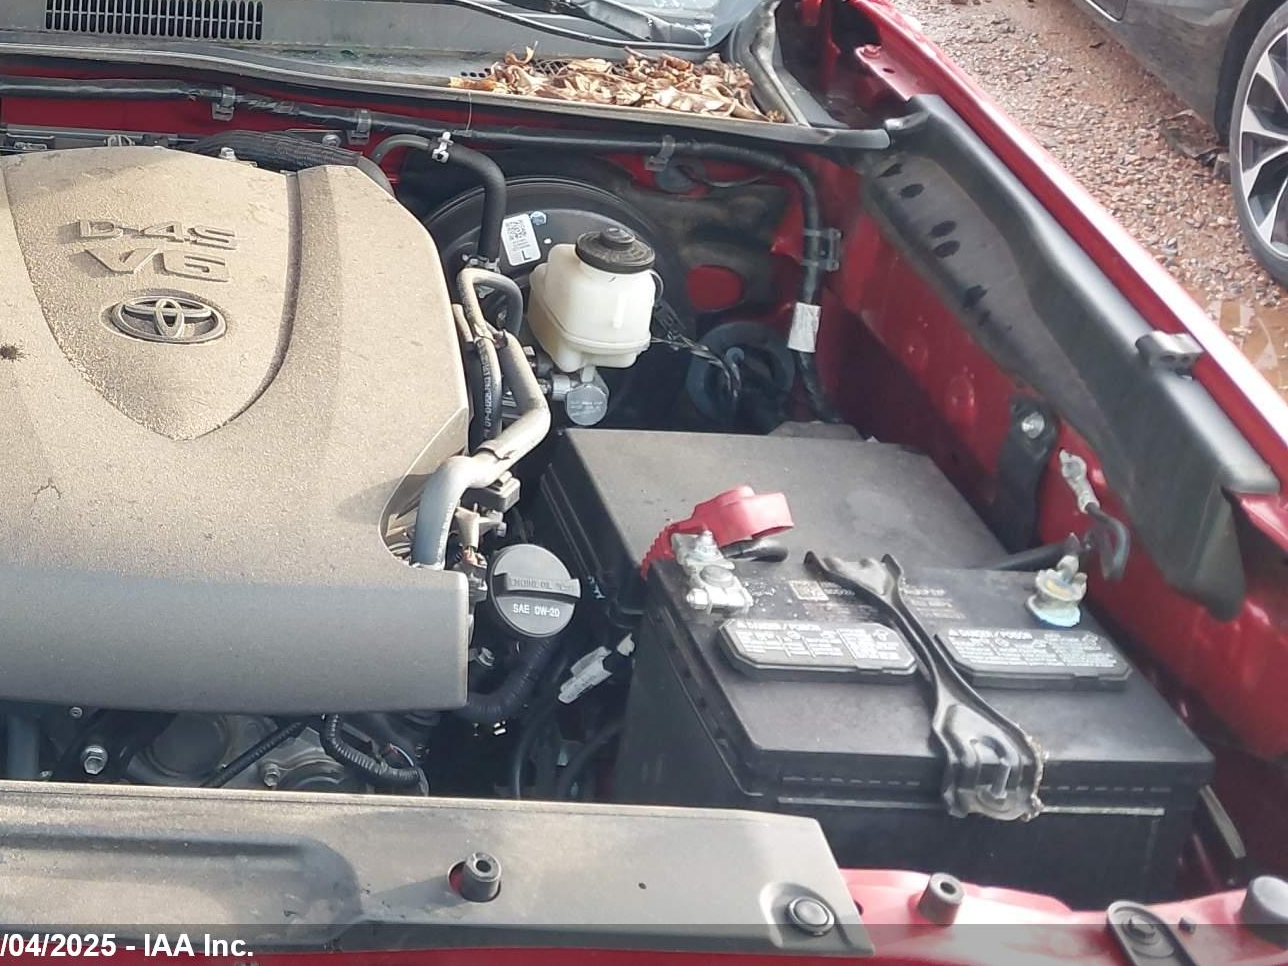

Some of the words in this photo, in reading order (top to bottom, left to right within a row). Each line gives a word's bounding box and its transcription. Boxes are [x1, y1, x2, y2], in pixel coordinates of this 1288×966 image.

[84, 247, 231, 282] V6
[512, 603, 530, 614] SAE
[534, 605, 560, 618] 0W-20
